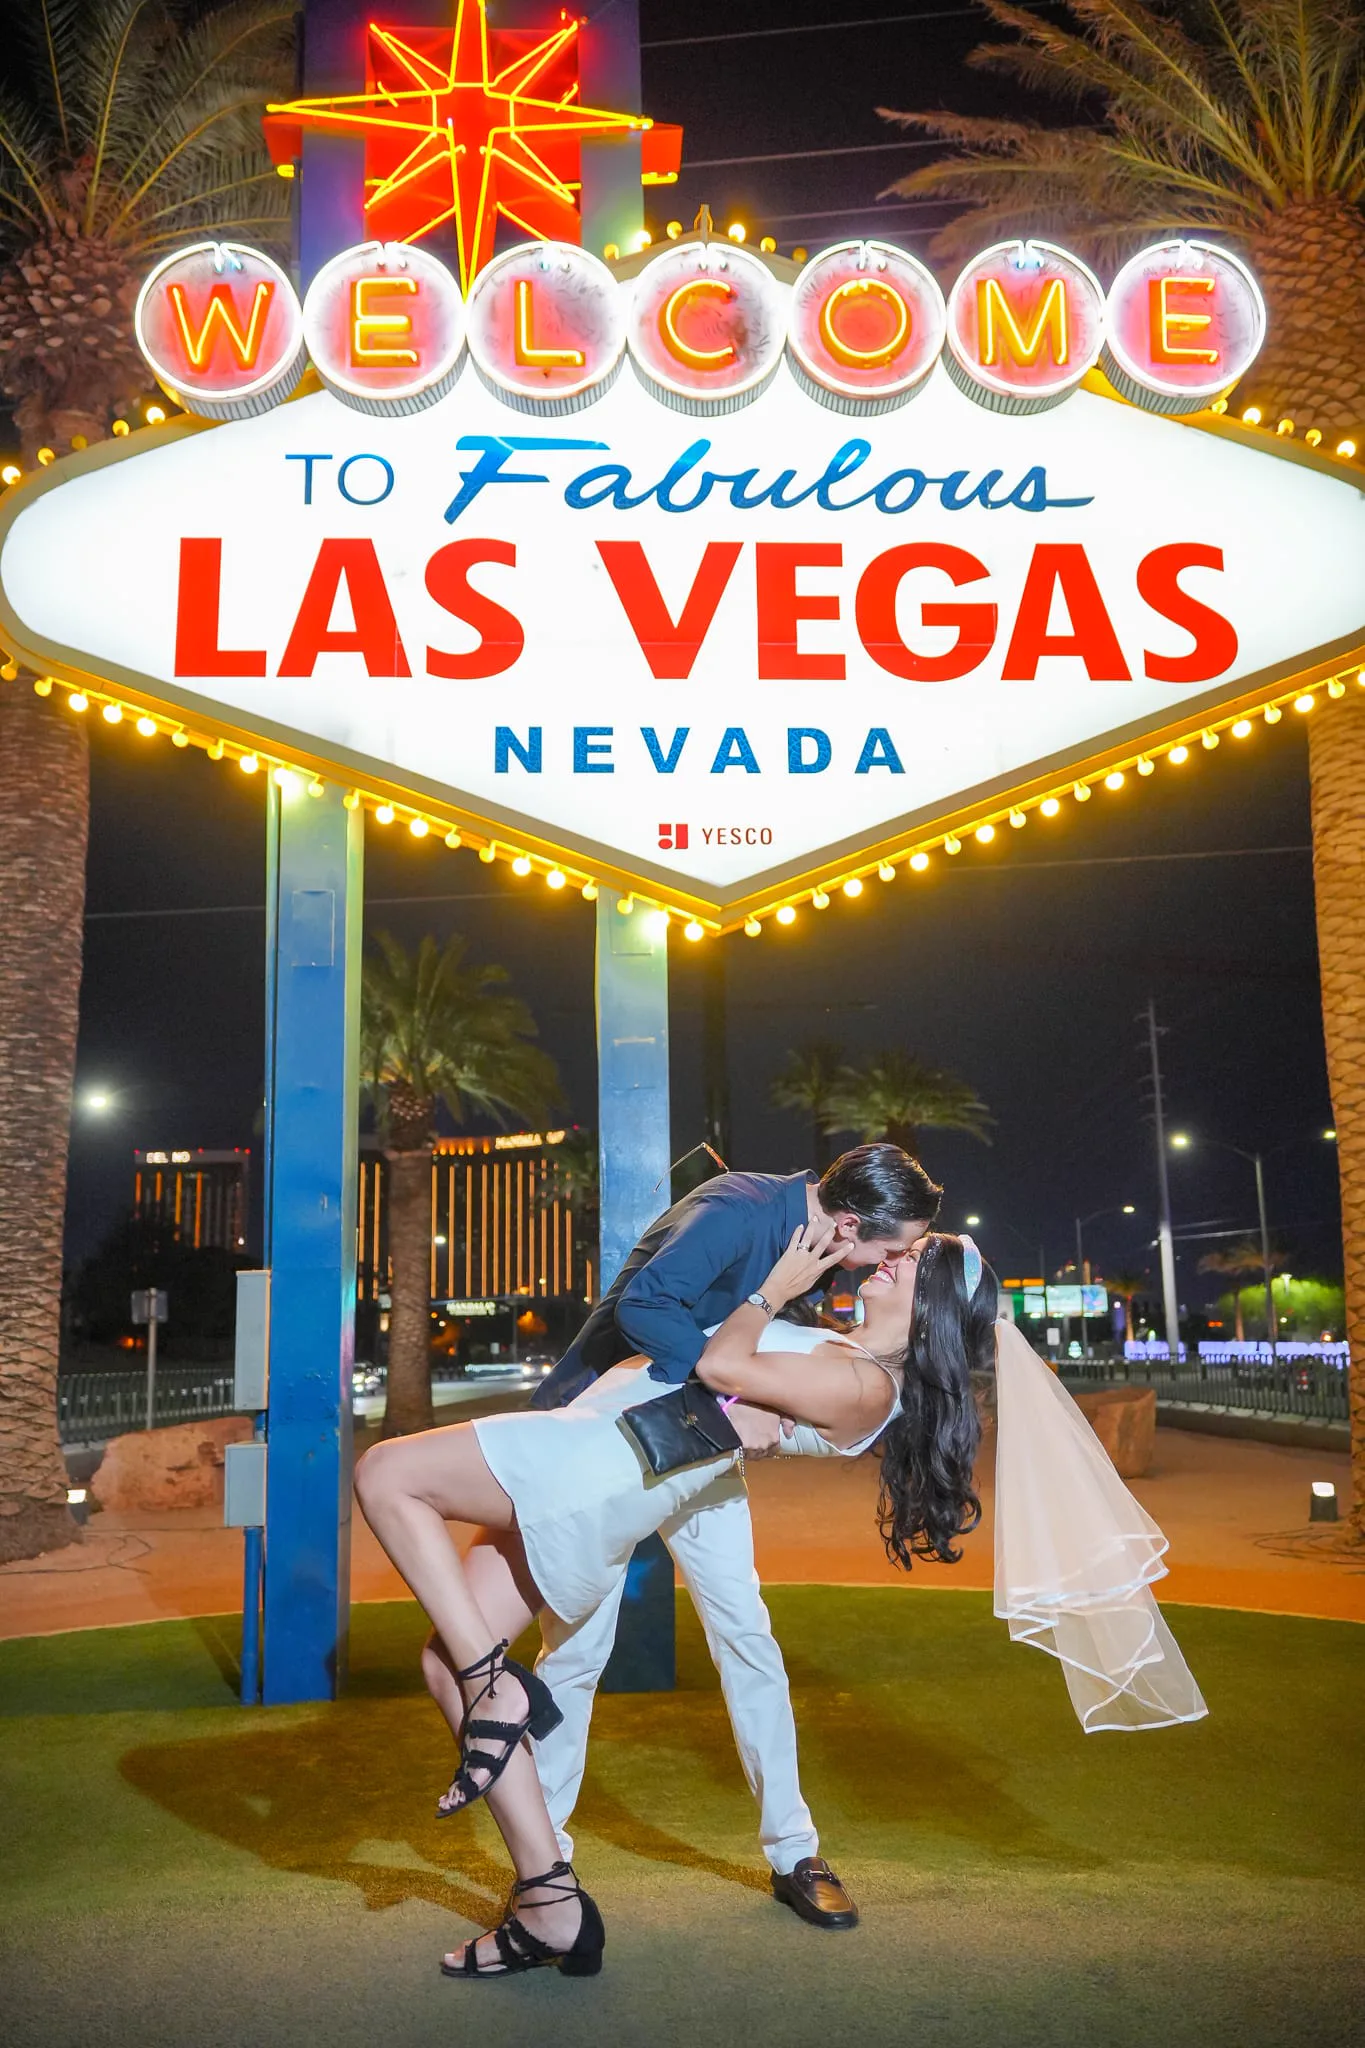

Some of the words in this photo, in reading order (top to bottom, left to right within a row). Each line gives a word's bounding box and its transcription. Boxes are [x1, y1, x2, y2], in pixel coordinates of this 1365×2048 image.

[166, 276, 1219, 371] WELCOME
[285, 454, 394, 505] TO
[444, 436, 1094, 525] Fabulous
[174, 537, 525, 680] LAS
[595, 540, 1238, 683] VEGAS
[495, 726, 905, 774] NEVADA
[702, 828, 772, 845] YESCO
